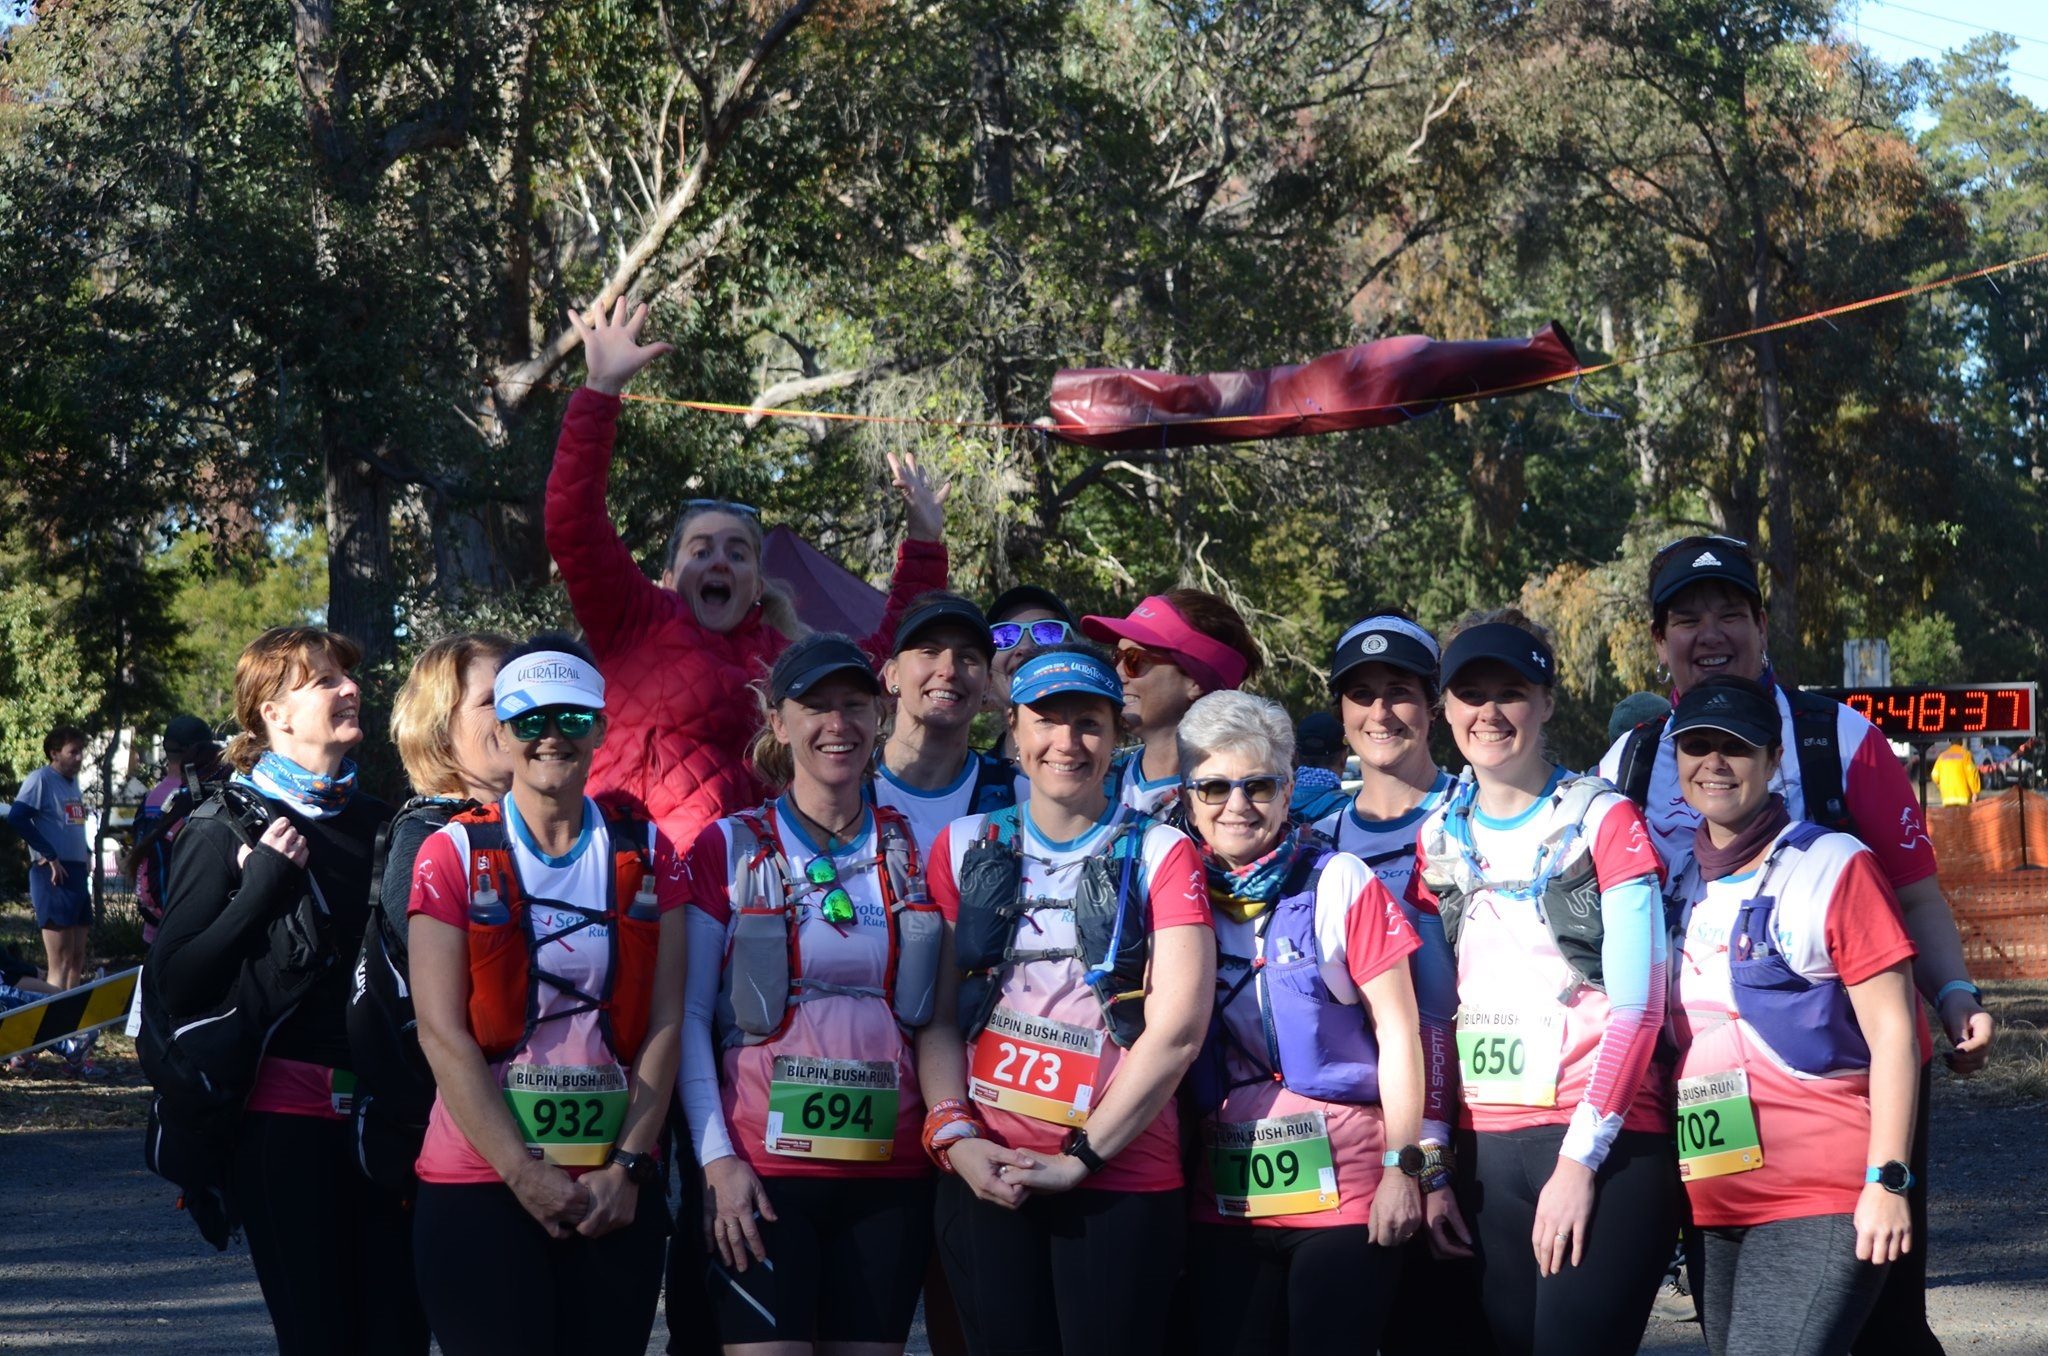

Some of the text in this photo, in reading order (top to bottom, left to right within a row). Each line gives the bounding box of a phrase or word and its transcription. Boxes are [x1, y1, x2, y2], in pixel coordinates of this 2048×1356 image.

[990, 1012, 1089, 1048] BILPIN BUSH RUN
[1464, 1013, 1490, 1025] BILPIN
[787, 1065, 890, 1083] BILPIN BUSH RUN
[992, 1041, 1062, 1092] 273
[1472, 1037, 1526, 1076] 650
[516, 1072, 619, 1087] BILPIN BUSH RUN
[1683, 1080, 1736, 1100] BUSH RUN
[533, 1098, 604, 1138] 932
[802, 1091, 874, 1133] 694
[1248, 1126, 1283, 1142] BUSH
[1286, 1121, 1314, 1137] RUN
[1229, 1149, 1300, 1190] 709
